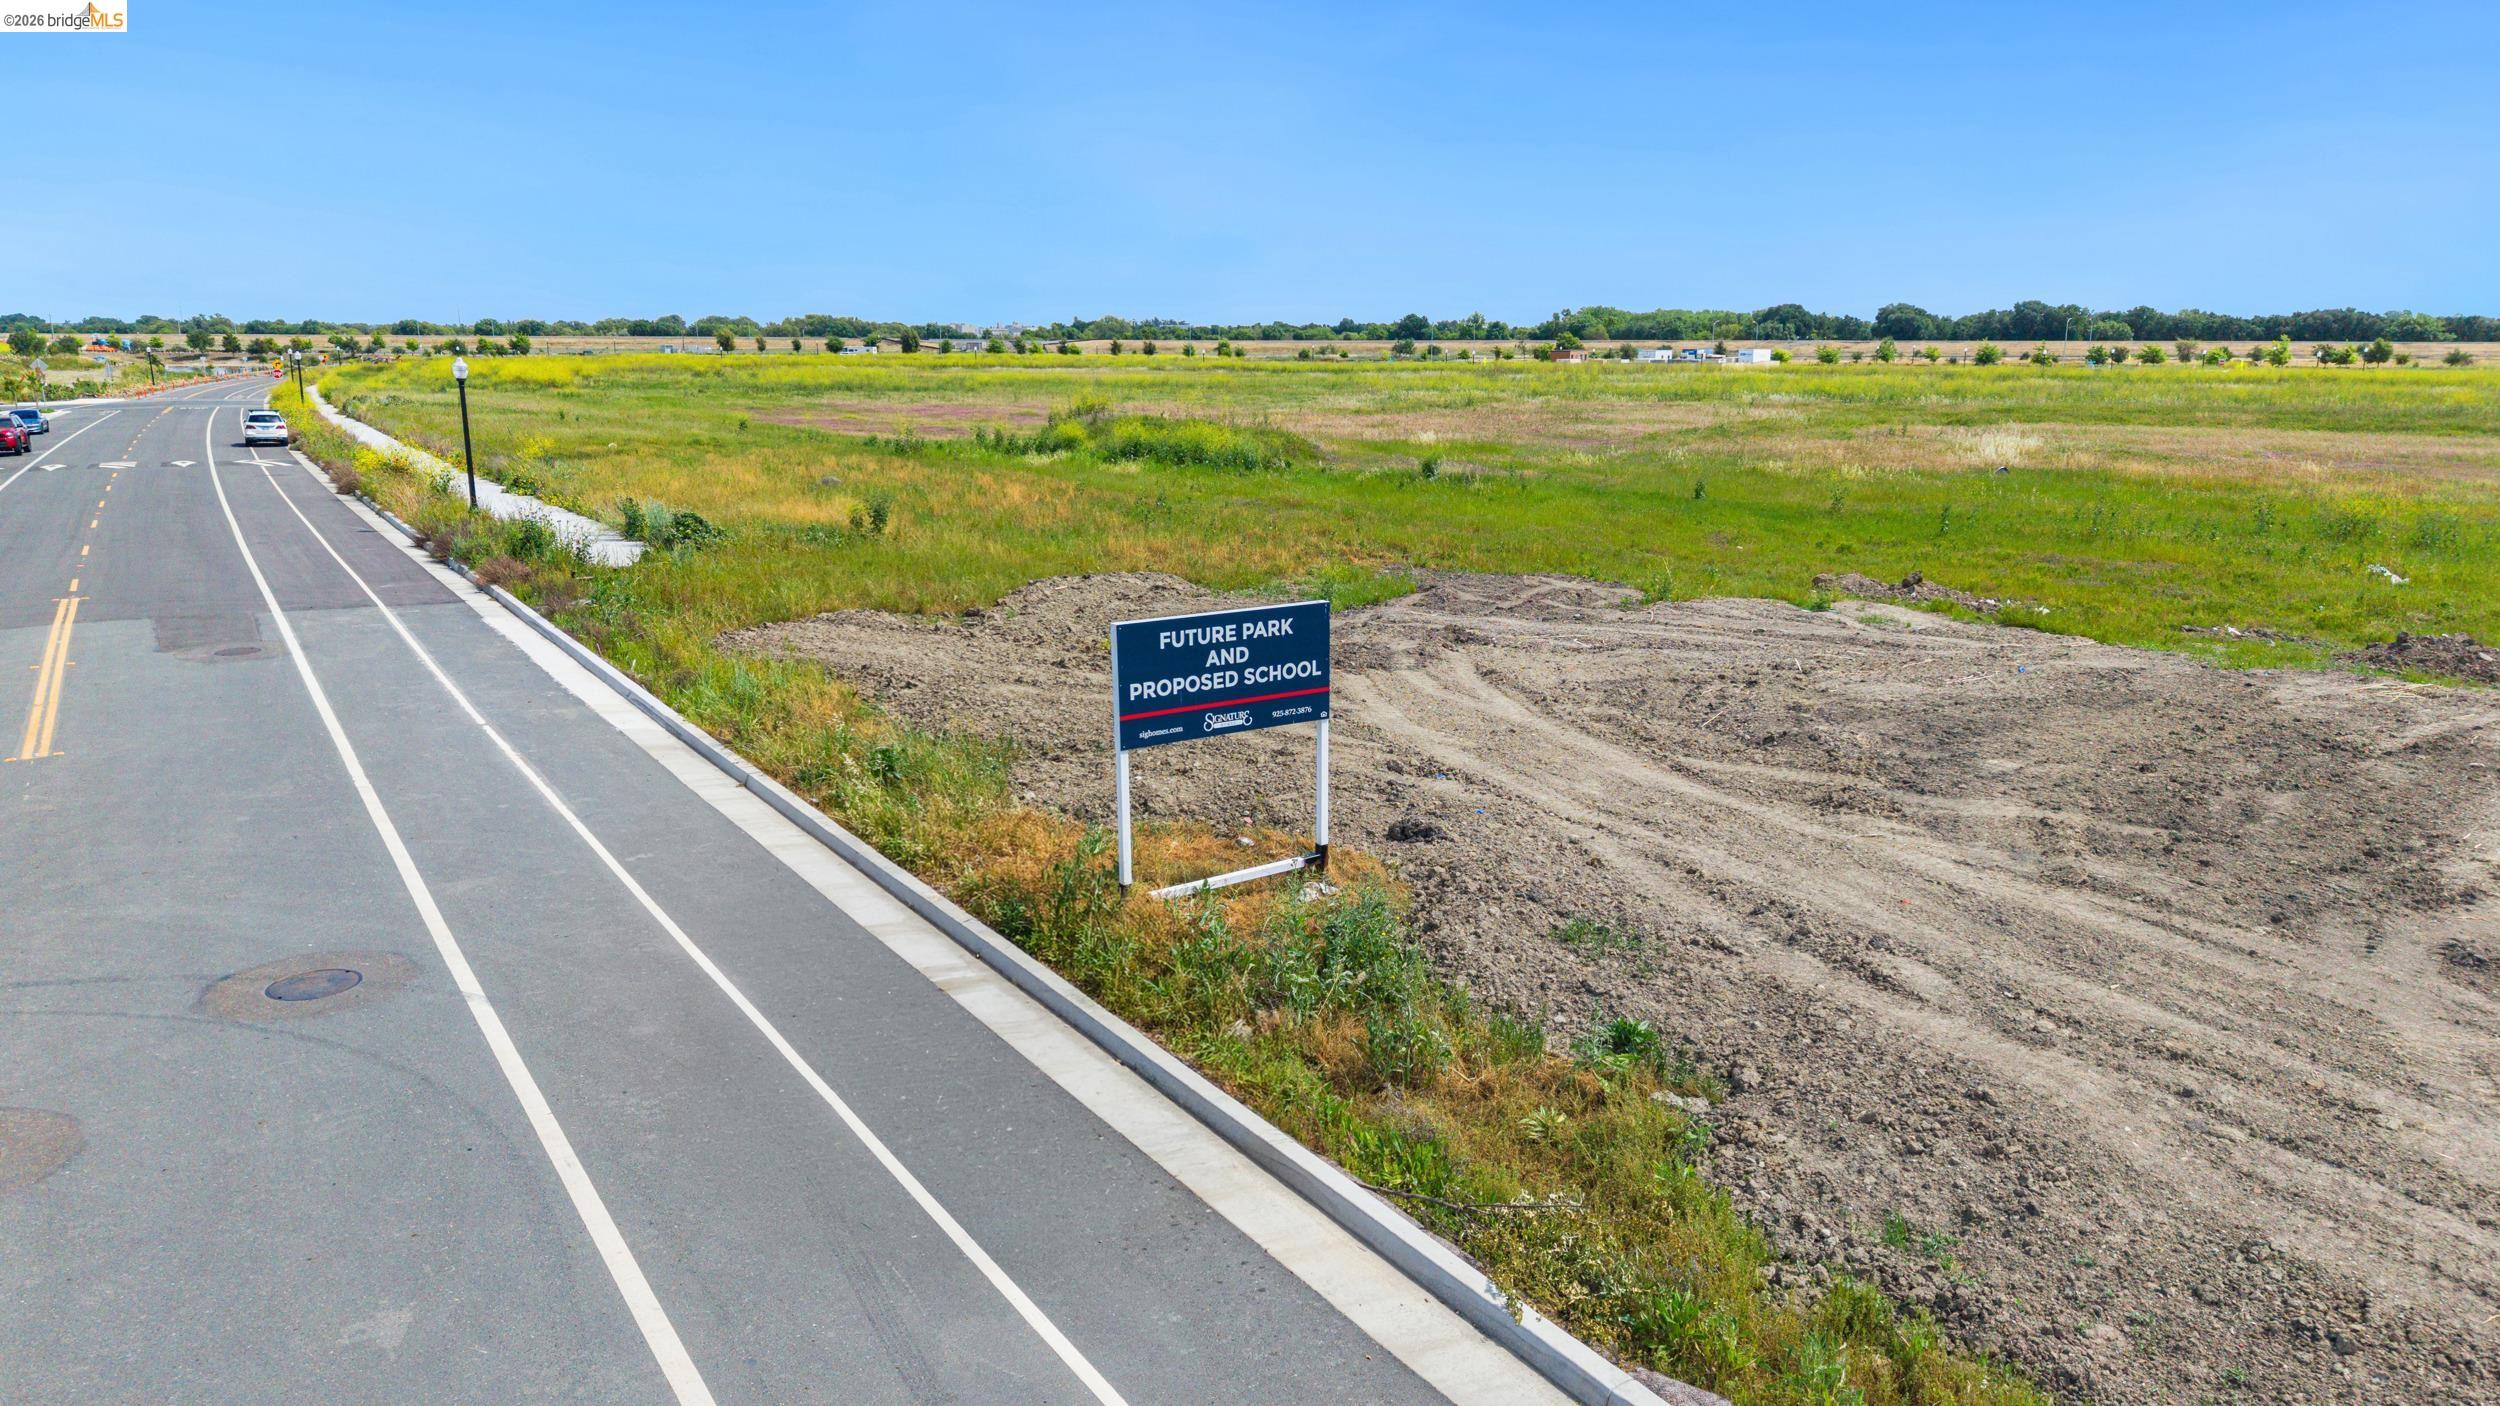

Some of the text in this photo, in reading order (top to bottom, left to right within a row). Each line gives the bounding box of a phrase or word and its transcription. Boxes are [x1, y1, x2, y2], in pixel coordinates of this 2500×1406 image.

[1159, 617, 1294, 650] FUTURE PARK
[1205, 646, 1250, 668] AND
[1129, 659, 1322, 701] PROPOSED SCHOOL
[1203, 710, 1253, 732] SIGNATURE
[1139, 726, 1184, 740] sighomes.com
